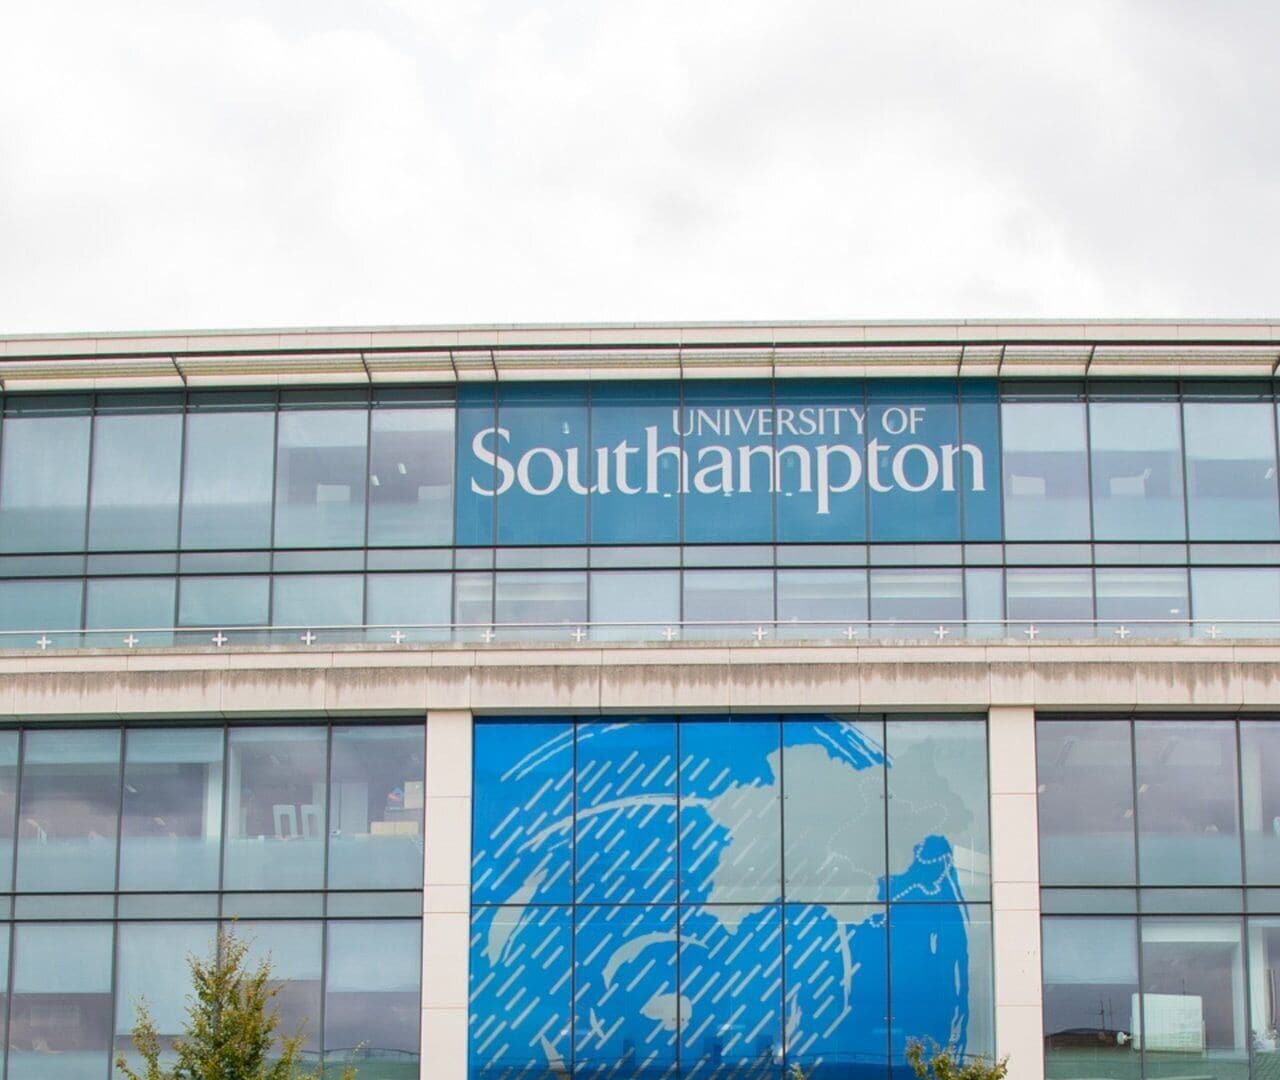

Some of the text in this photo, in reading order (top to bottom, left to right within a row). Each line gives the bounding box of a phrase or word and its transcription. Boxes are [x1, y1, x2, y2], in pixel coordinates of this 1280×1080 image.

[672, 406, 926, 437] UNIVERSITY OF
[470, 425, 986, 514] Southampton
